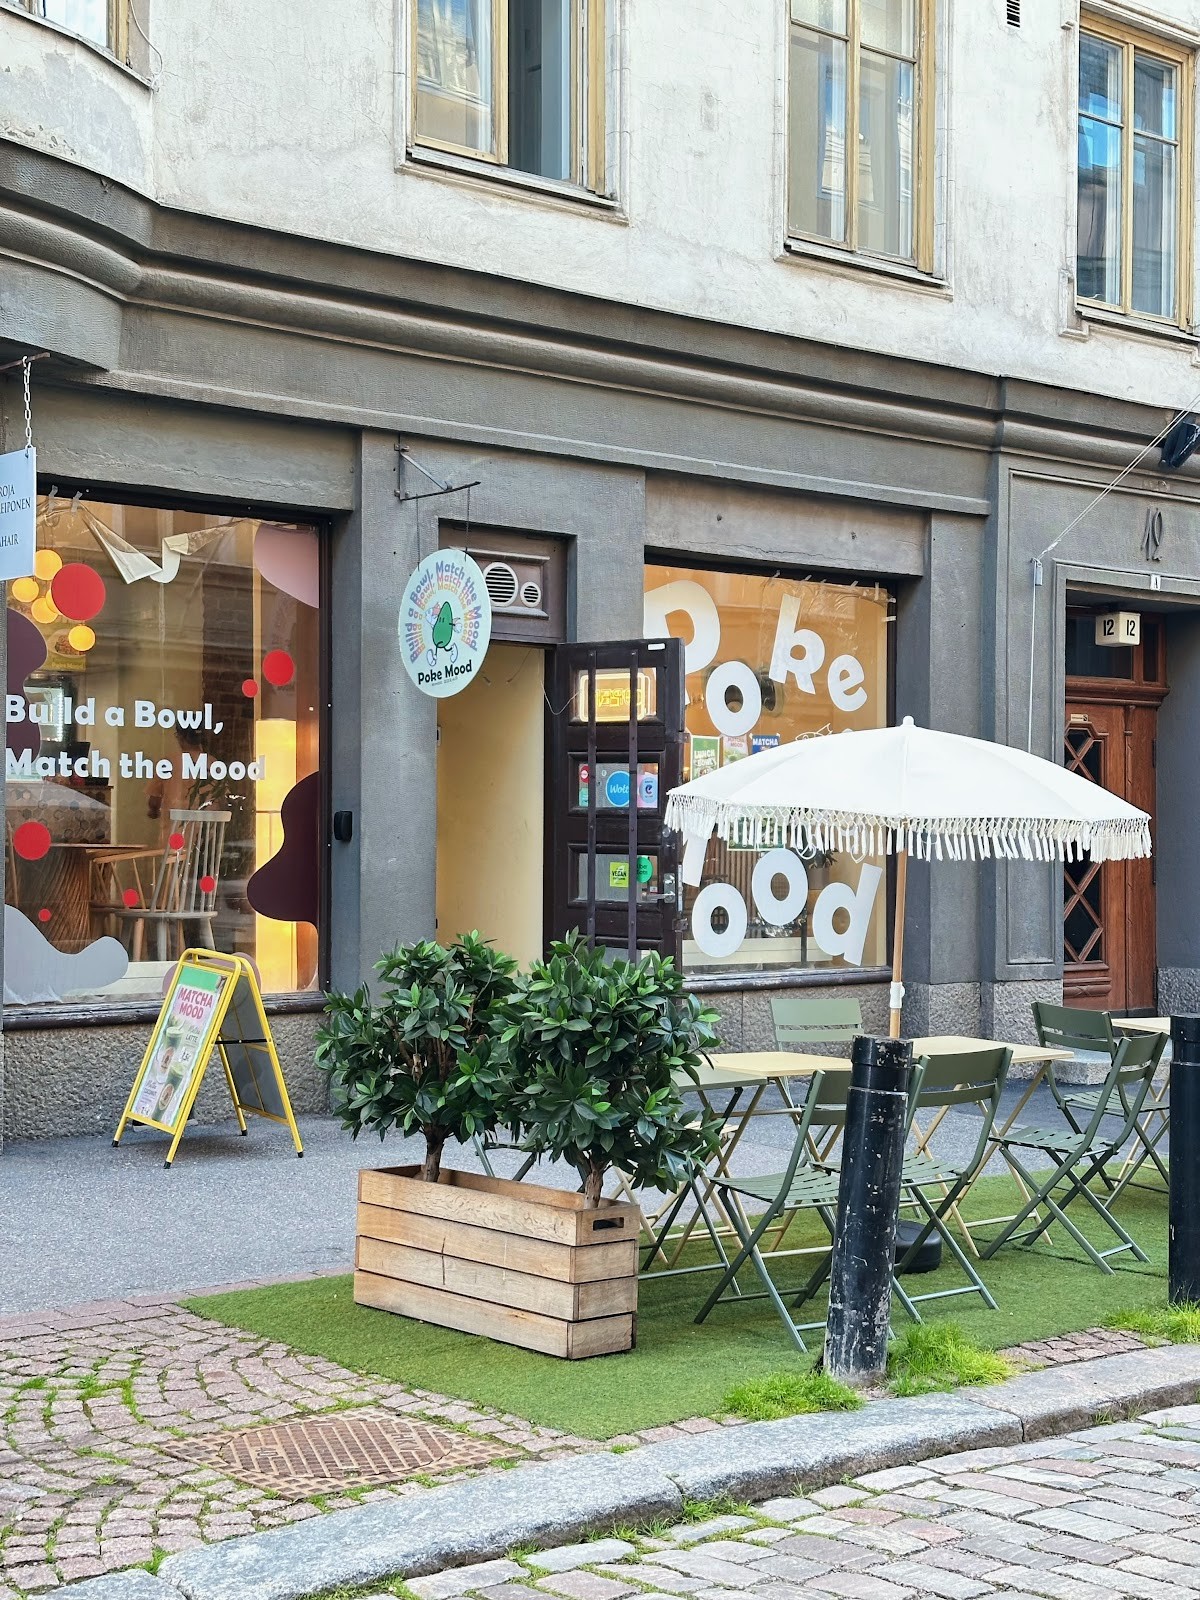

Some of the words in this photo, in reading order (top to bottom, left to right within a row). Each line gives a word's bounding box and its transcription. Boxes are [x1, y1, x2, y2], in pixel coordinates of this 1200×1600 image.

[0, 497, 31, 515] EIPONEN
[1103, 618, 1115, 637] 12
[1126, 619, 1136, 637] 12
[643, 579, 868, 738] Poke
[417, 669, 443, 686] Poke
[444, 659, 473, 679] Mood
[6, 694, 96, 726] Build
[105, 705, 125, 727] a
[134, 699, 224, 735] Bowl,
[752, 737, 779, 746] MATCHA
[6, 747, 111, 779] Match
[119, 751, 173, 780] the
[181, 752, 266, 781] Mood
[178, 987, 213, 1008] MATCHA
[179, 1002, 204, 1020] MOOD
